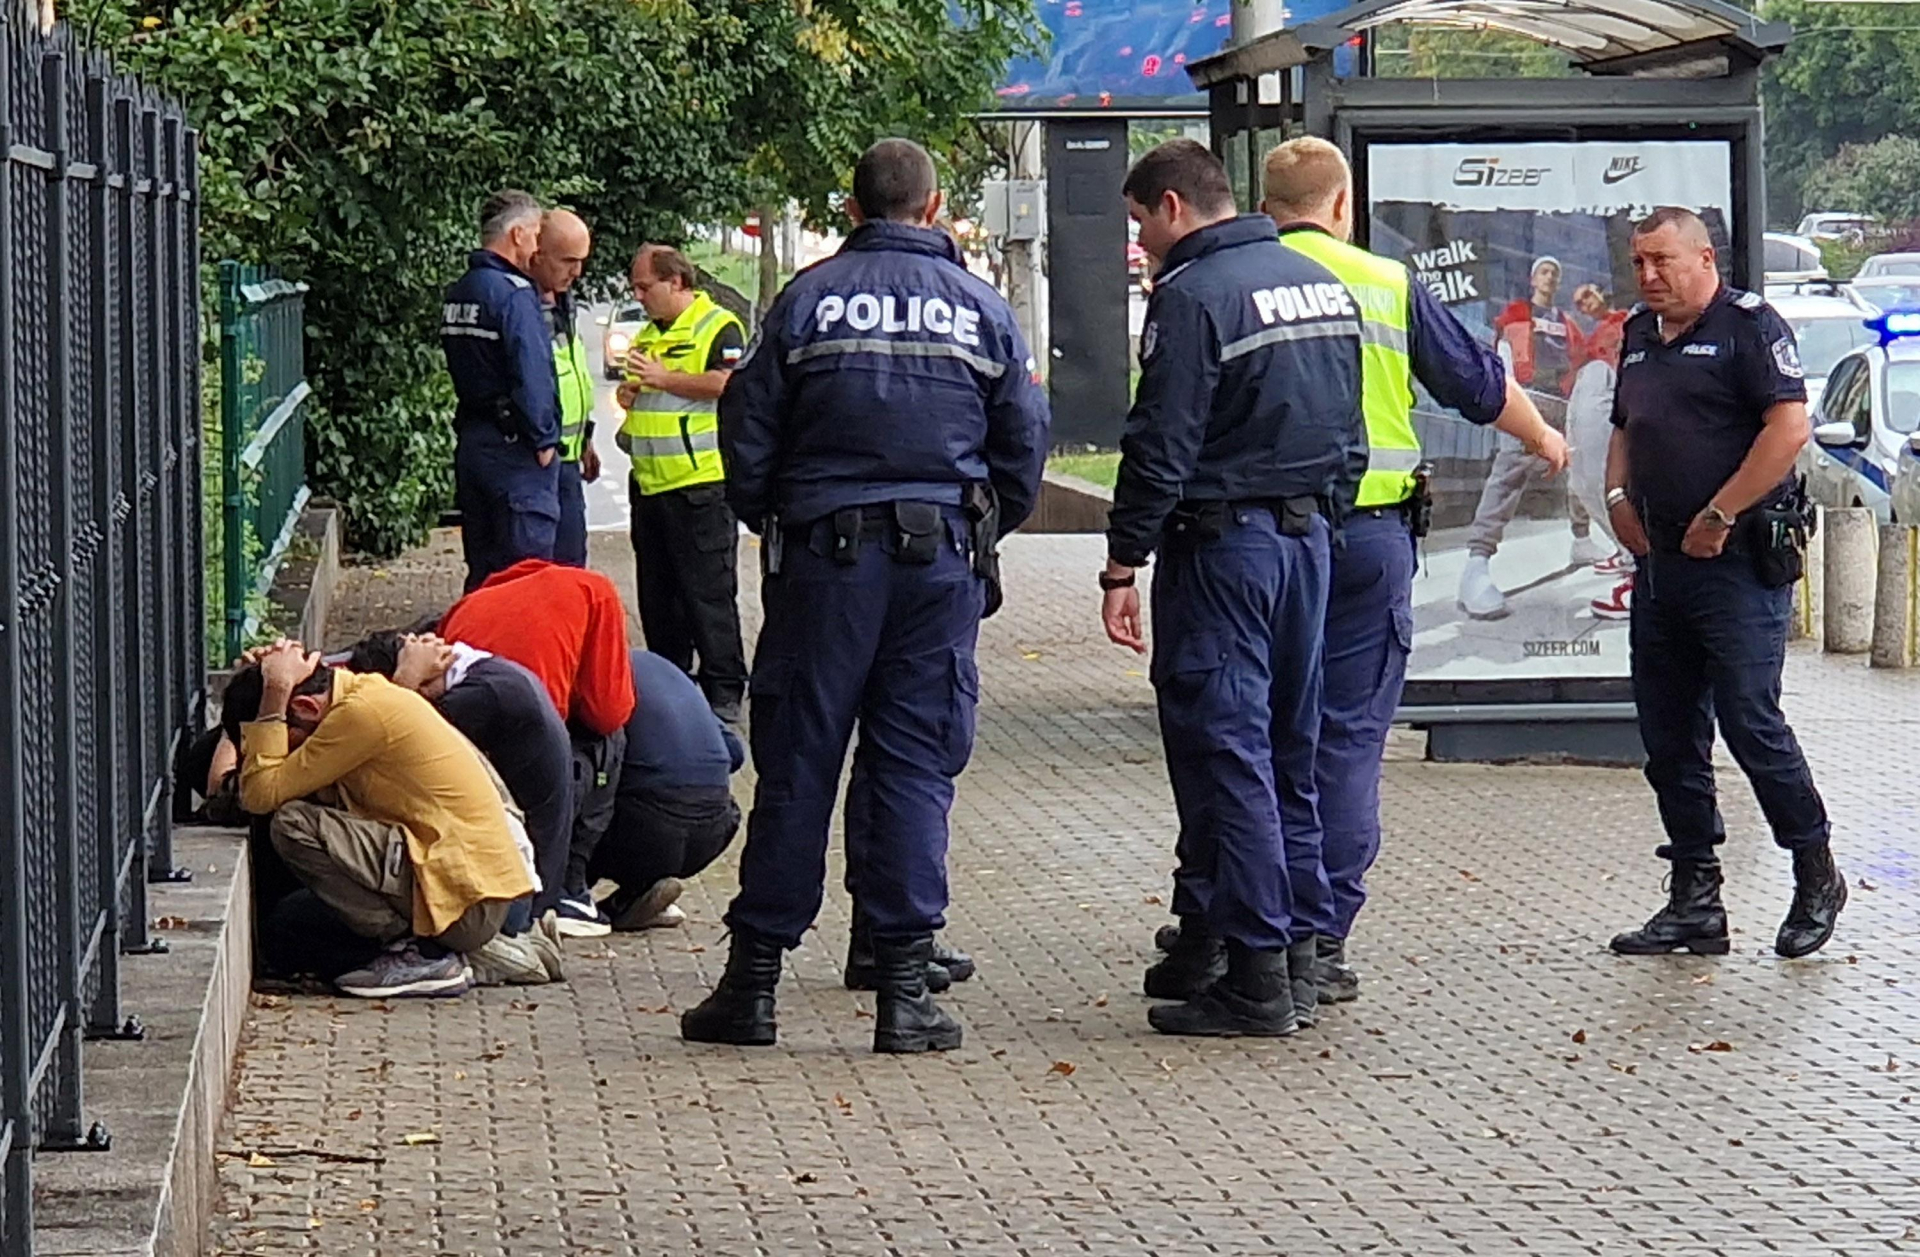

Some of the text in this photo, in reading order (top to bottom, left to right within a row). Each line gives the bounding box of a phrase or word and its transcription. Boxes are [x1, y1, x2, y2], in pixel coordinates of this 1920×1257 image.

[1609, 156, 1641, 172] NIKE
[1411, 239, 1478, 270] walk
[1426, 270, 1479, 302] alk
[816, 293, 980, 346] POLICE
[1252, 283, 1355, 325] POLICE
[1522, 640, 1600, 657] SIZEER.COM
